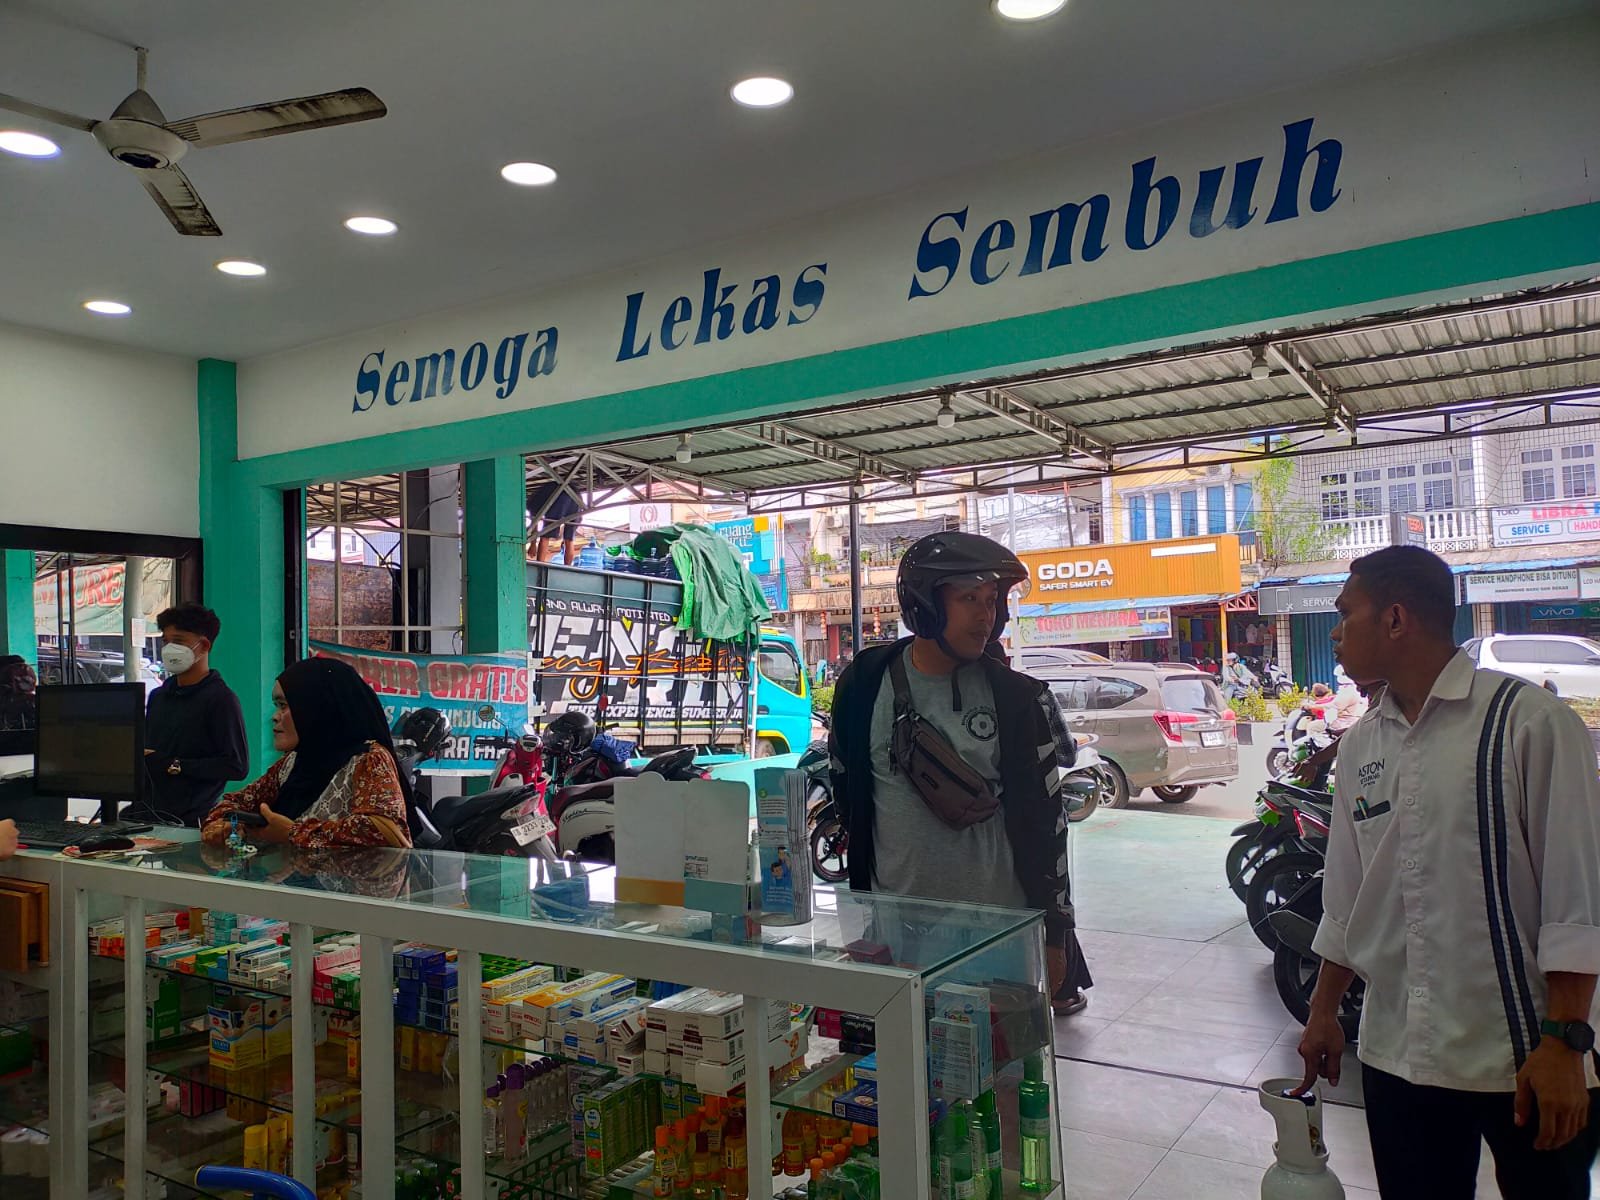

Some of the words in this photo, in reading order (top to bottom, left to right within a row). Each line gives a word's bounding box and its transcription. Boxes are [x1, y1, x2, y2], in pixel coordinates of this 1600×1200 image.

[353, 327, 559, 412] Semoga
[616, 263, 827, 361] Lekas
[908, 117, 1342, 301] Sembuh
[1531, 502, 1588, 521] LIBRA
[1511, 524, 1551, 536] SERVICE
[1038, 559, 1114, 580] GODA
[1039, 582, 1068, 591] SAFER
[1070, 580, 1098, 589] SMART
[1100, 578, 1113, 587] EV
[1470, 575, 1495, 585] SERVICE
[1496, 574, 1535, 584] HANDPHONE
[1302, 598, 1336, 608] SERVIC
[616, 607, 671, 622] MOTIATED
[1036, 614, 1073, 633] TOKO
[1075, 608, 1140, 629] MENARA
[427, 661, 528, 704] GRATIS
[1358, 758, 1385, 777] ASTON
